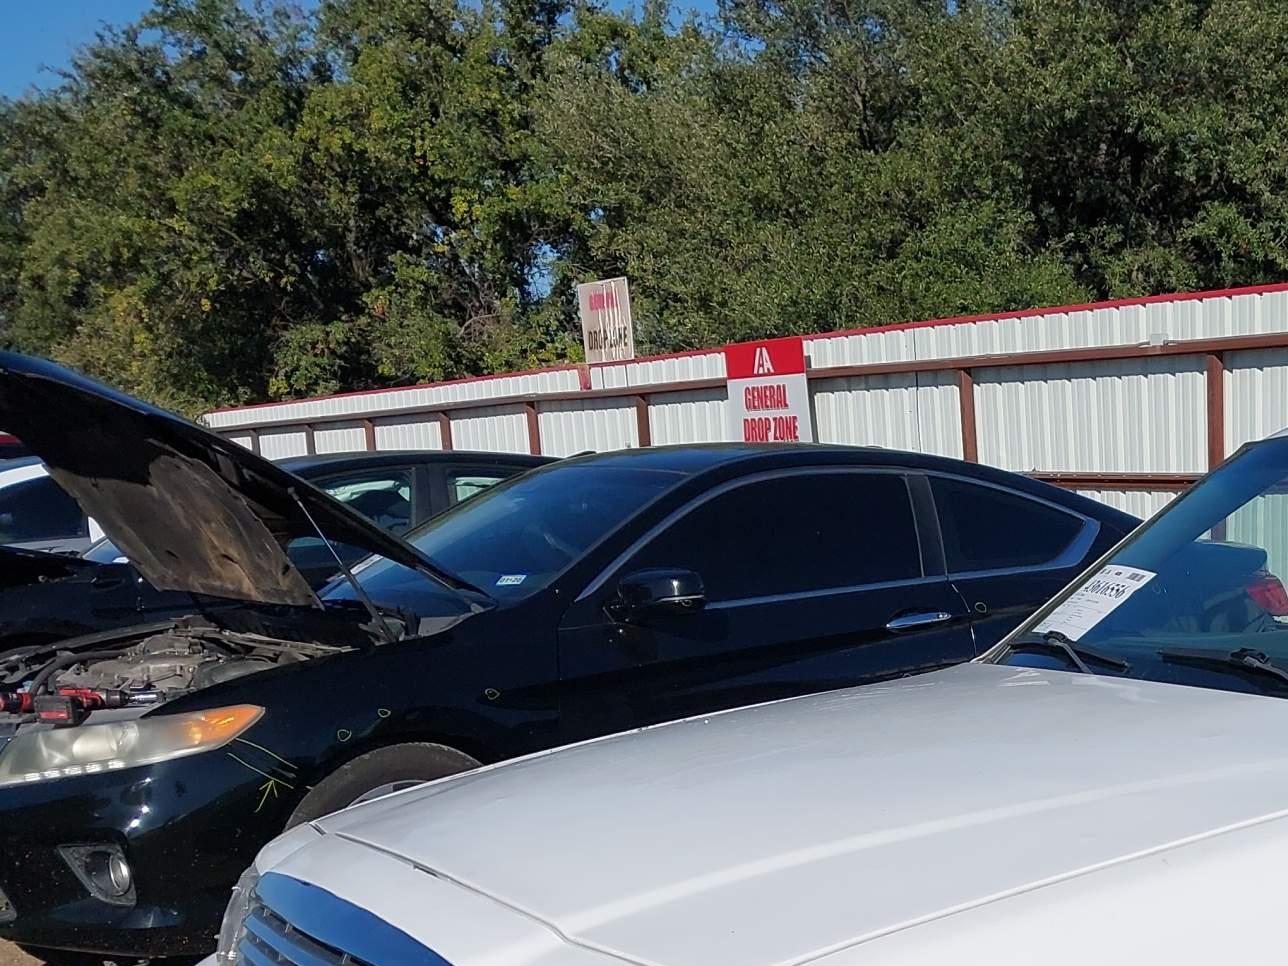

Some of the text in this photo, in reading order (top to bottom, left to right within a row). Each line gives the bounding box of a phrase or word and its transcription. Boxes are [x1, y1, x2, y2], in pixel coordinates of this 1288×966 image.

[744, 384, 790, 411] GENERAL
[743, 415, 800, 442] DROP ZONE
